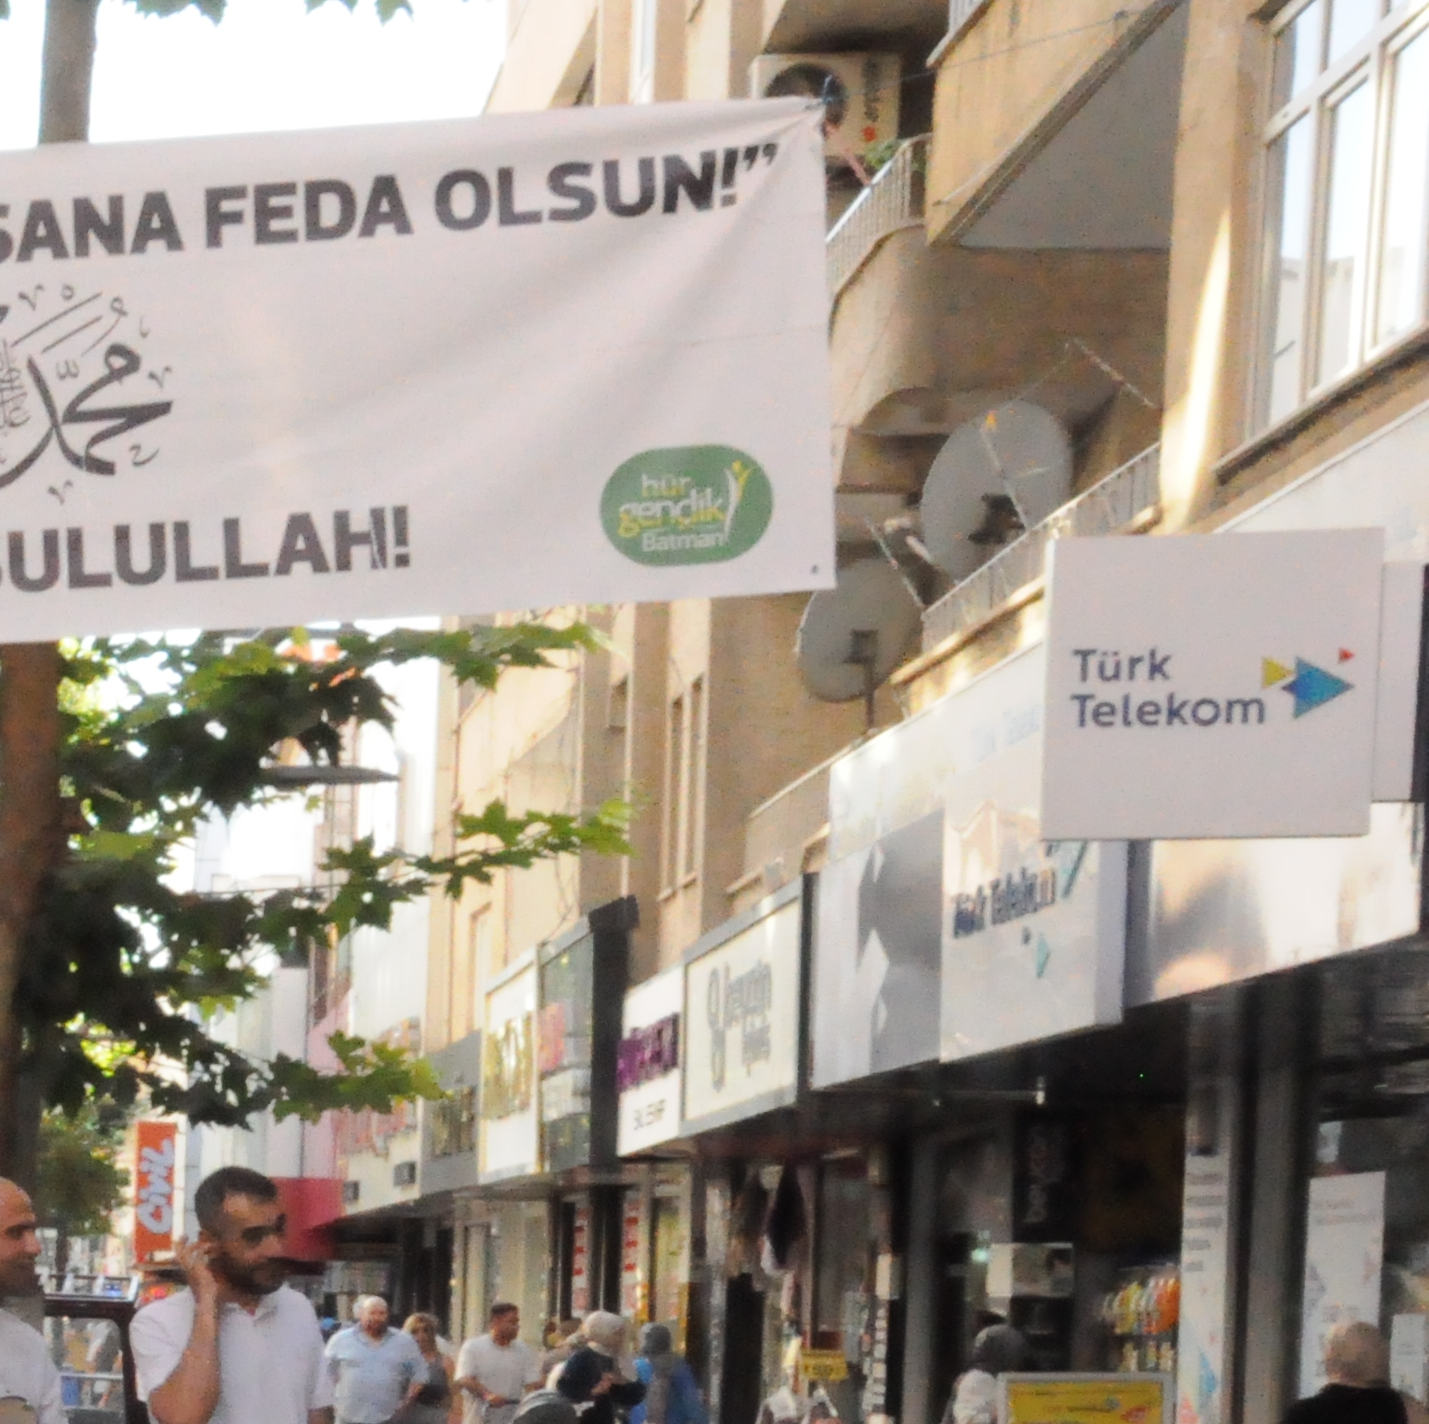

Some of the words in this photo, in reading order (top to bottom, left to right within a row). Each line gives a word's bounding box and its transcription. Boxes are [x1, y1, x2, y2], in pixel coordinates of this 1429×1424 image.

[205, 173, 414, 249] FEDA
[1072, 647, 1172, 683] Türk
[1071, 694, 1266, 728] Telekom
